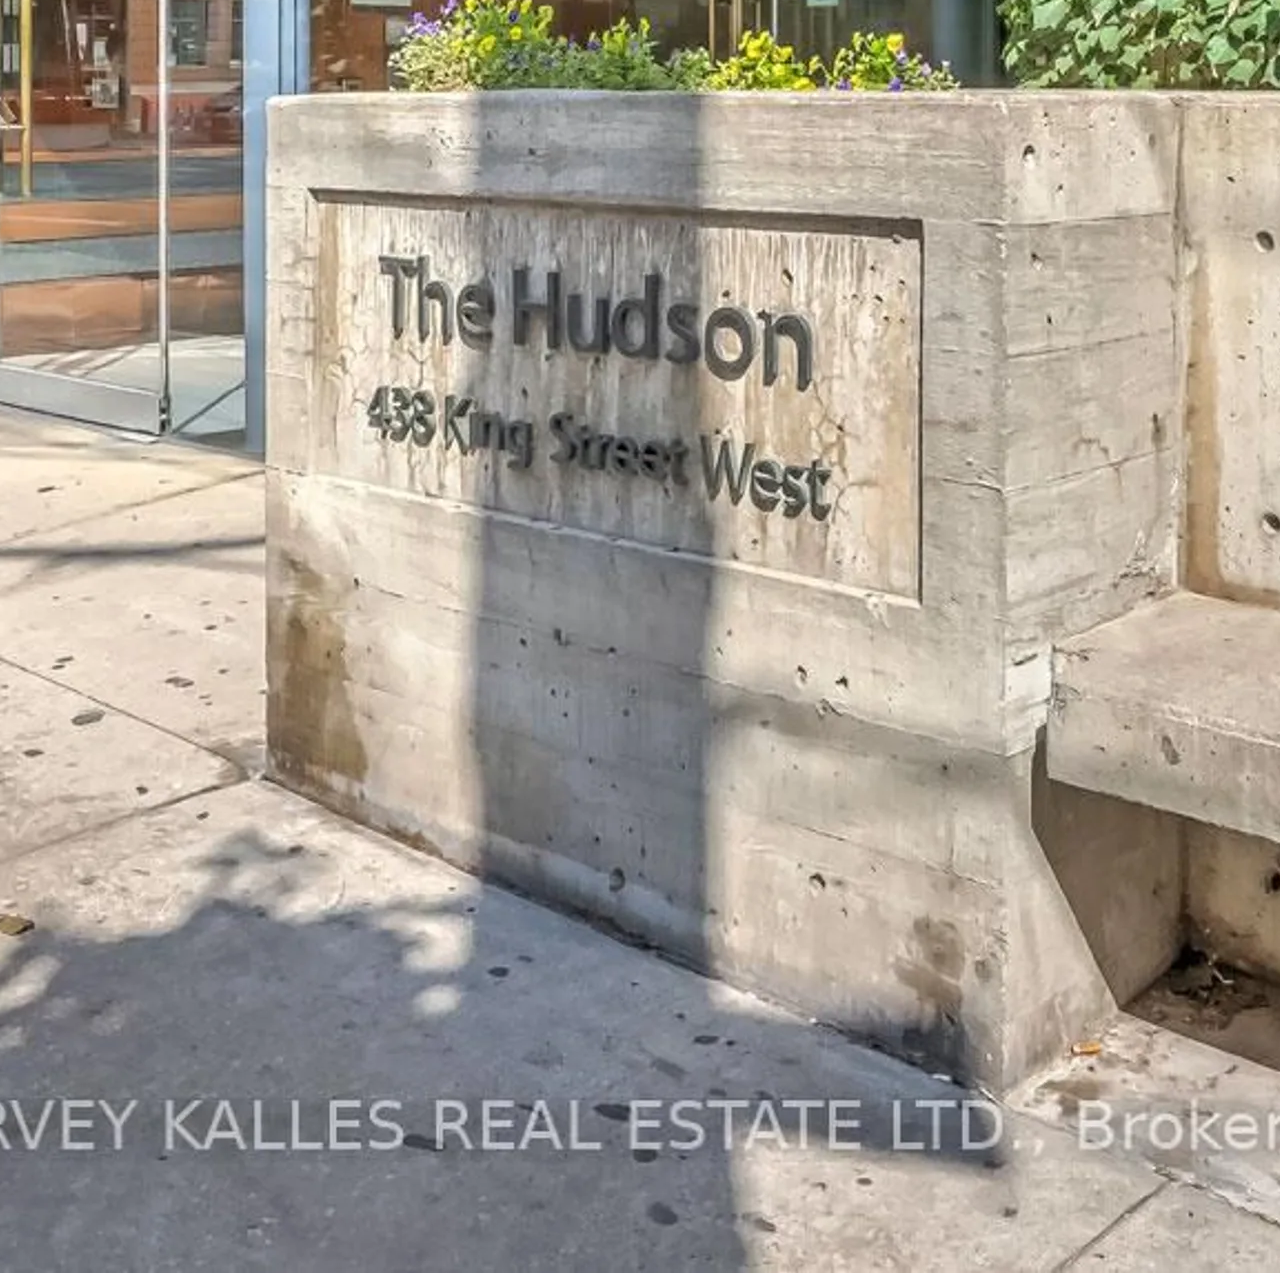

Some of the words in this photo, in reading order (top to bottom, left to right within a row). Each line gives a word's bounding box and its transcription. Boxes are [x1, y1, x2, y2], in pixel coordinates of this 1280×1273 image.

[379, 255, 495, 350] The
[512, 267, 813, 393] Hudson
[366, 385, 436, 448] 438
[444, 393, 533, 469] King
[549, 411, 690, 486] Street
[700, 434, 832, 522] West
